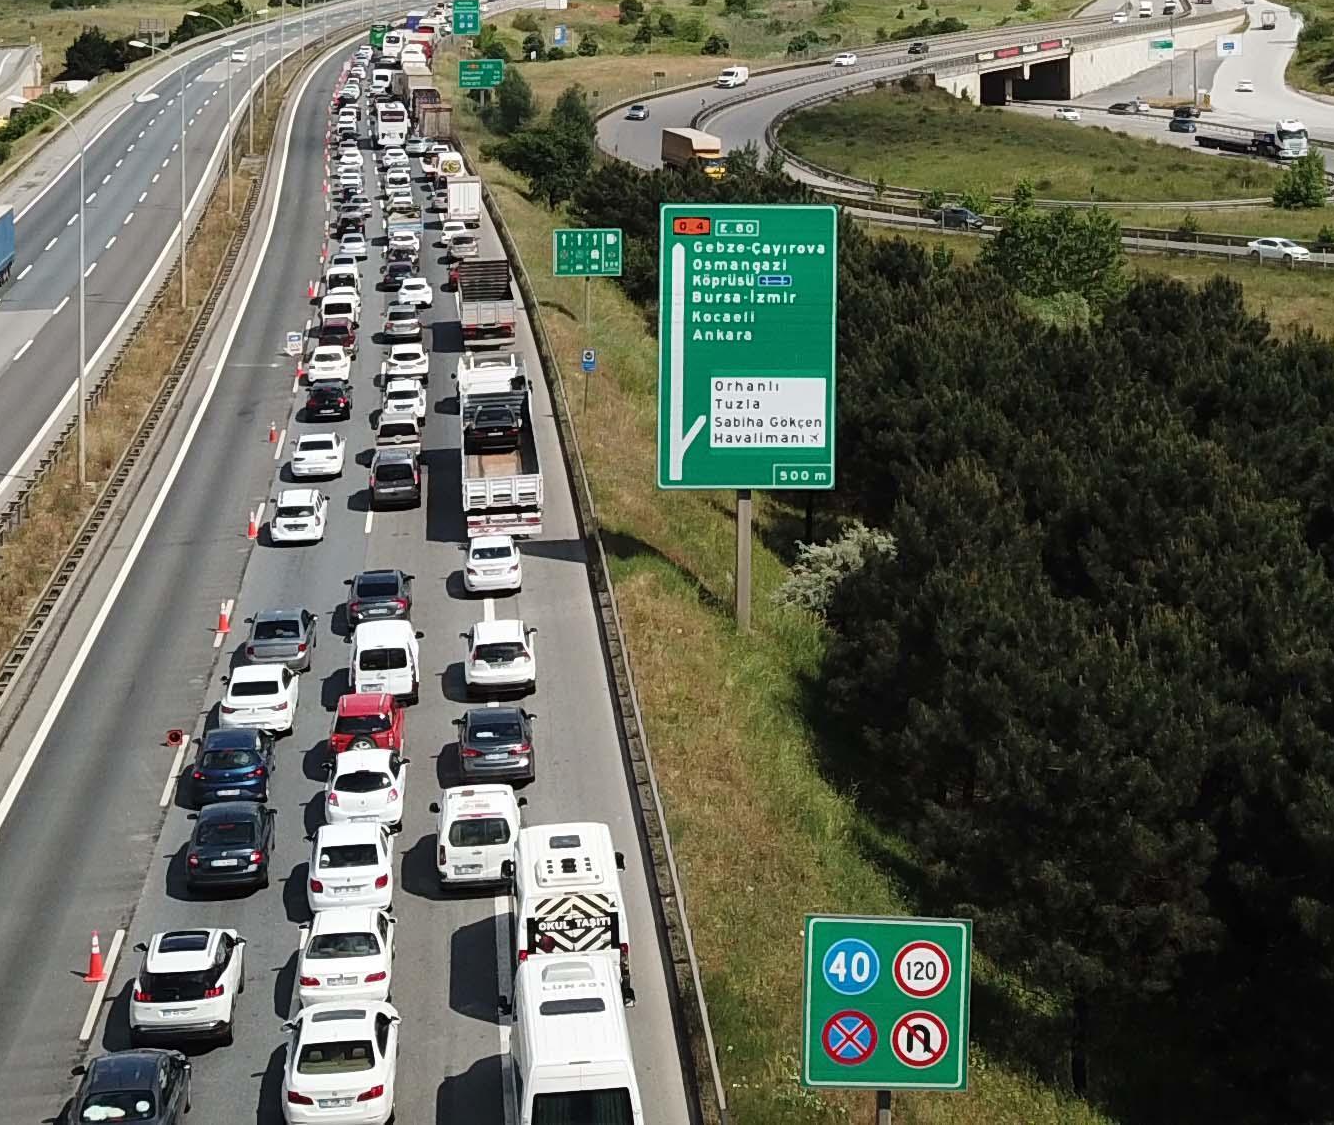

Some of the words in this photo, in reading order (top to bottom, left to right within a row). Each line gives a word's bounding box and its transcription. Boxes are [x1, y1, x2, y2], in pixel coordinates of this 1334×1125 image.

[692, 258, 787, 275] Osmangazi
[692, 273, 755, 289] Köprüsü
[692, 311, 755, 323] Kocaeli
[692, 329, 752, 341] Ankara
[714, 398, 761, 410] Tuzla
[714, 416, 764, 428] Sabiha
[769, 416, 822, 430] Gökçen
[814, 472, 827, 481] m
[538, 920, 570, 931] OKUL
[828, 951, 870, 983] 40
[906, 961, 937, 981] 120
